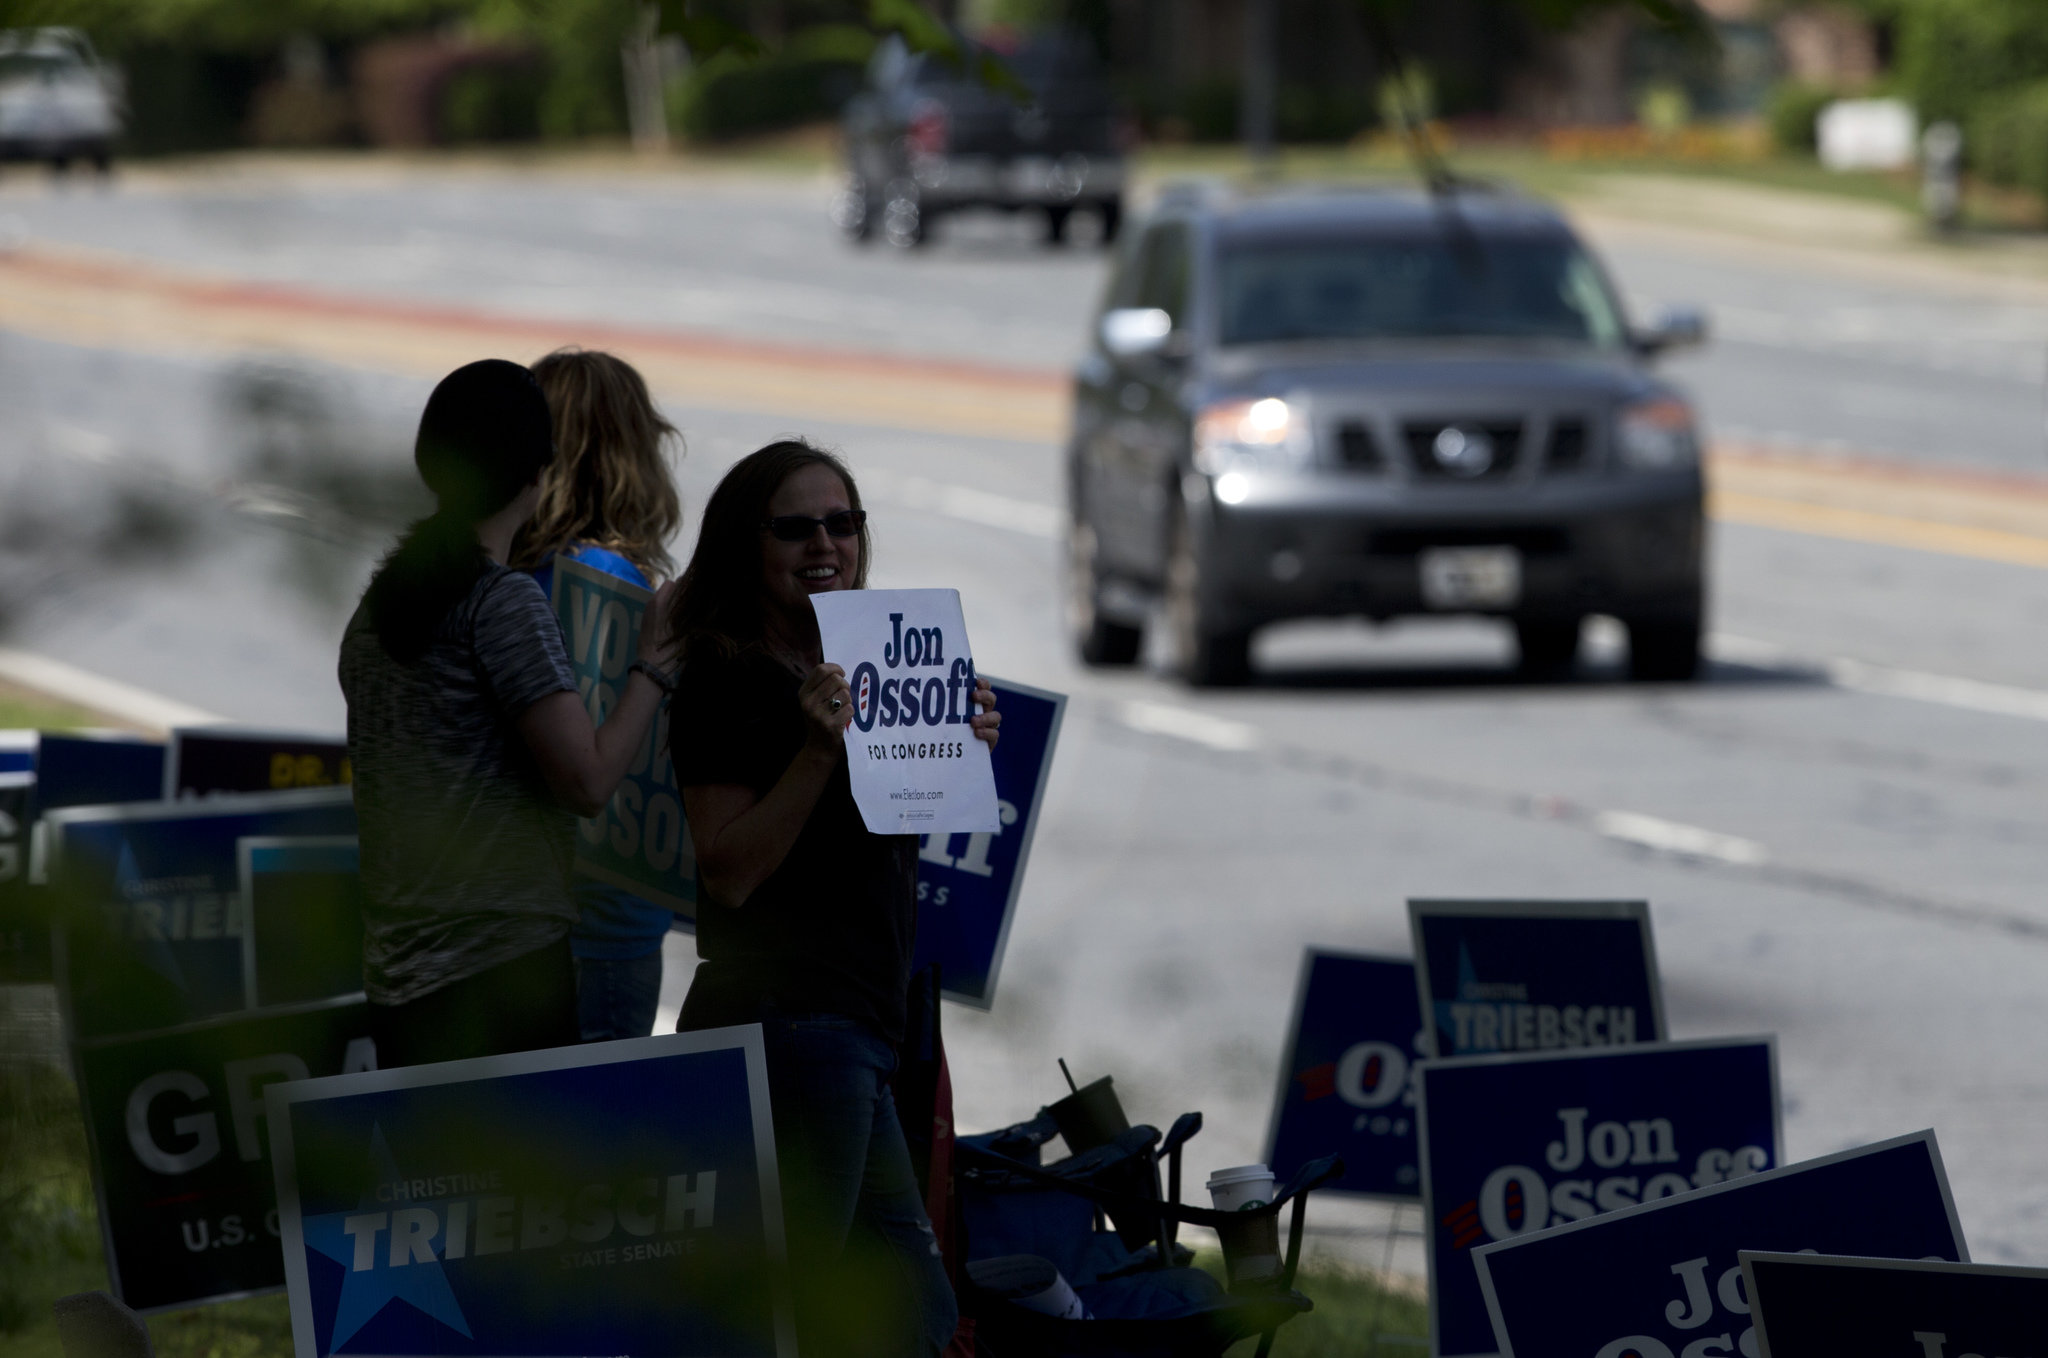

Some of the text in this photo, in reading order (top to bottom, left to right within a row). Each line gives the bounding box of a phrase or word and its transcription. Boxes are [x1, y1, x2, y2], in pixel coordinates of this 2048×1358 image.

[884, 613, 944, 669] Jon
[851, 657, 977, 733] Ossoff
[868, 742, 963, 760] FOR CONGRESS
[1451, 1002, 1637, 1049] TRIEBSCH
[1545, 1106, 1680, 1173] Jon
[375, 1170, 503, 1203] CHRISTINE
[181, 1214, 256, 1254] U.S.
[344, 1170, 717, 1272] TRIEBSCH
[560, 1240, 698, 1270] STATE SENATE
[1665, 1256, 1751, 1330] Jo
